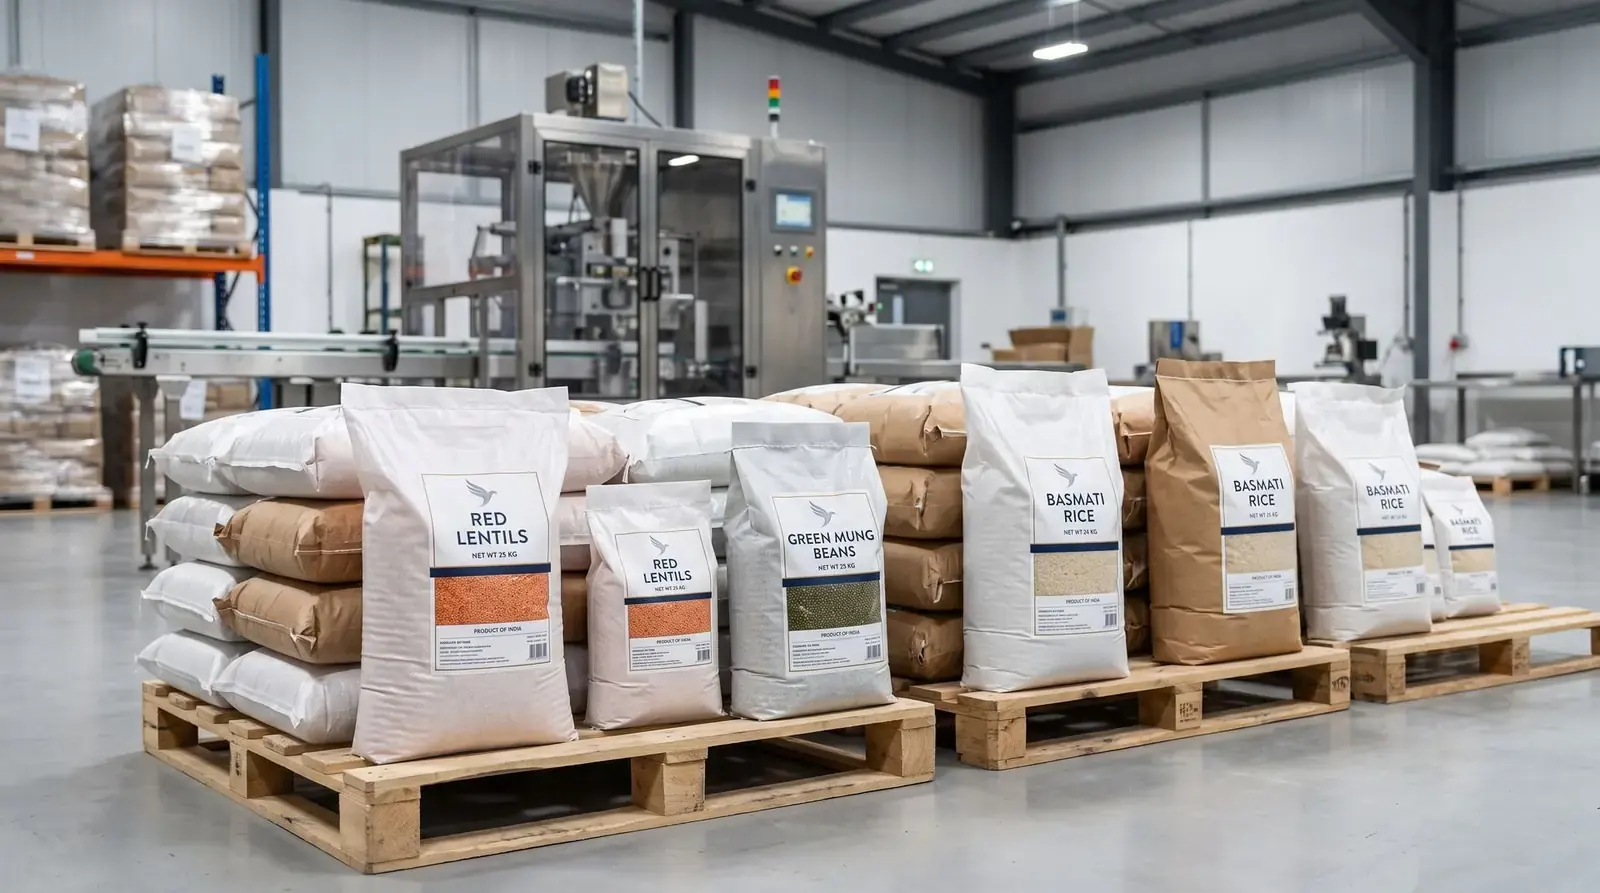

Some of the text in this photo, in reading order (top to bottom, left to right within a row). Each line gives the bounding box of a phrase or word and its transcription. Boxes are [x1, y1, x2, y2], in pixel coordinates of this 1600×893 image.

[1233, 478, 1285, 492] BASMATI
[1366, 484, 1410, 496] BASMATI
[1046, 492, 1105, 506] BASMATI
[1249, 494, 1276, 507] RICE
[1380, 498, 1404, 510] RICE
[470, 512, 507, 526] RED
[1064, 510, 1096, 522] RICE
[456, 529, 528, 546] LENTILS
[788, 529, 875, 545] GREEN MUNG
[813, 546, 856, 559] BEANS
[653, 558, 678, 570] RED
[643, 570, 692, 584] LENTILS
